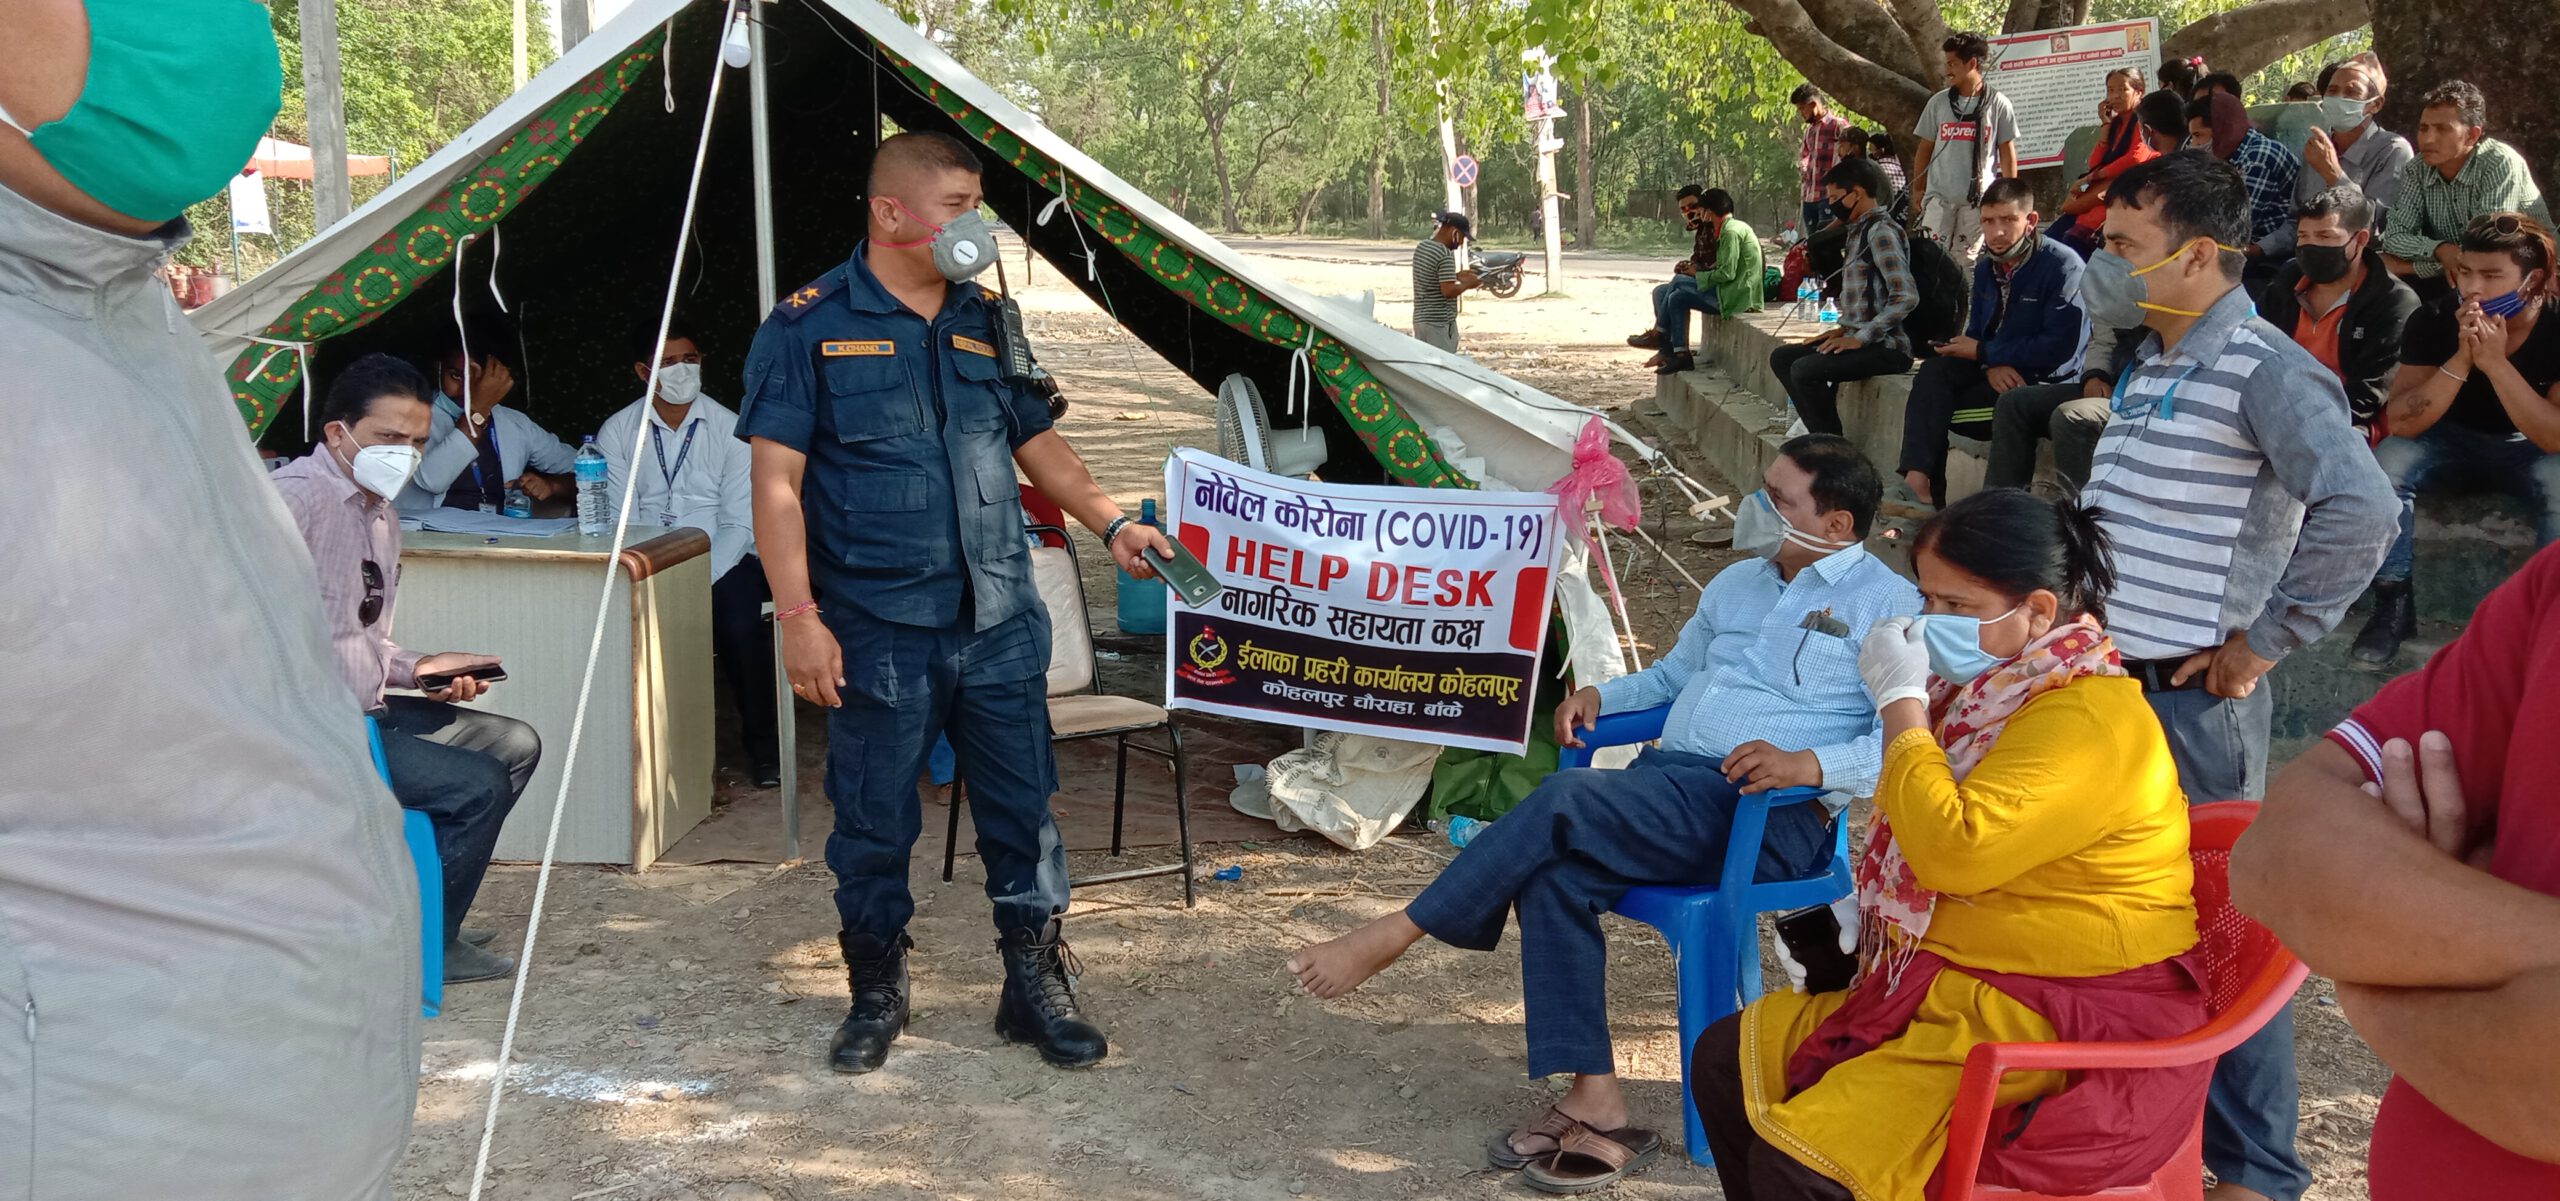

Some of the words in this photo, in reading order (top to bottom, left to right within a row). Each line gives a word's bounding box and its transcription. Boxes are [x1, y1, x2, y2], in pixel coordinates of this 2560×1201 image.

[1195, 472, 1267, 522] नोवेल
[1274, 495, 1367, 541] कोरोना
[1375, 509, 1542, 559] (COVID-19)
[1225, 535, 1349, 592] HELP
[1366, 561, 1497, 607] DESK
[1221, 585, 1319, 627] नागरिक
[1326, 606, 1425, 645] सहायता
[1431, 619, 1485, 650] कक्ष
[1237, 640, 1299, 675] ईलाका
[1303, 656, 1350, 685] प्रहरी
[1353, 665, 1436, 694] कार्यालय
[1439, 667, 1522, 706] कोहलपुर
[1262, 679, 1348, 708] कोहलपुर
[1424, 700, 1464, 717] बाँके
